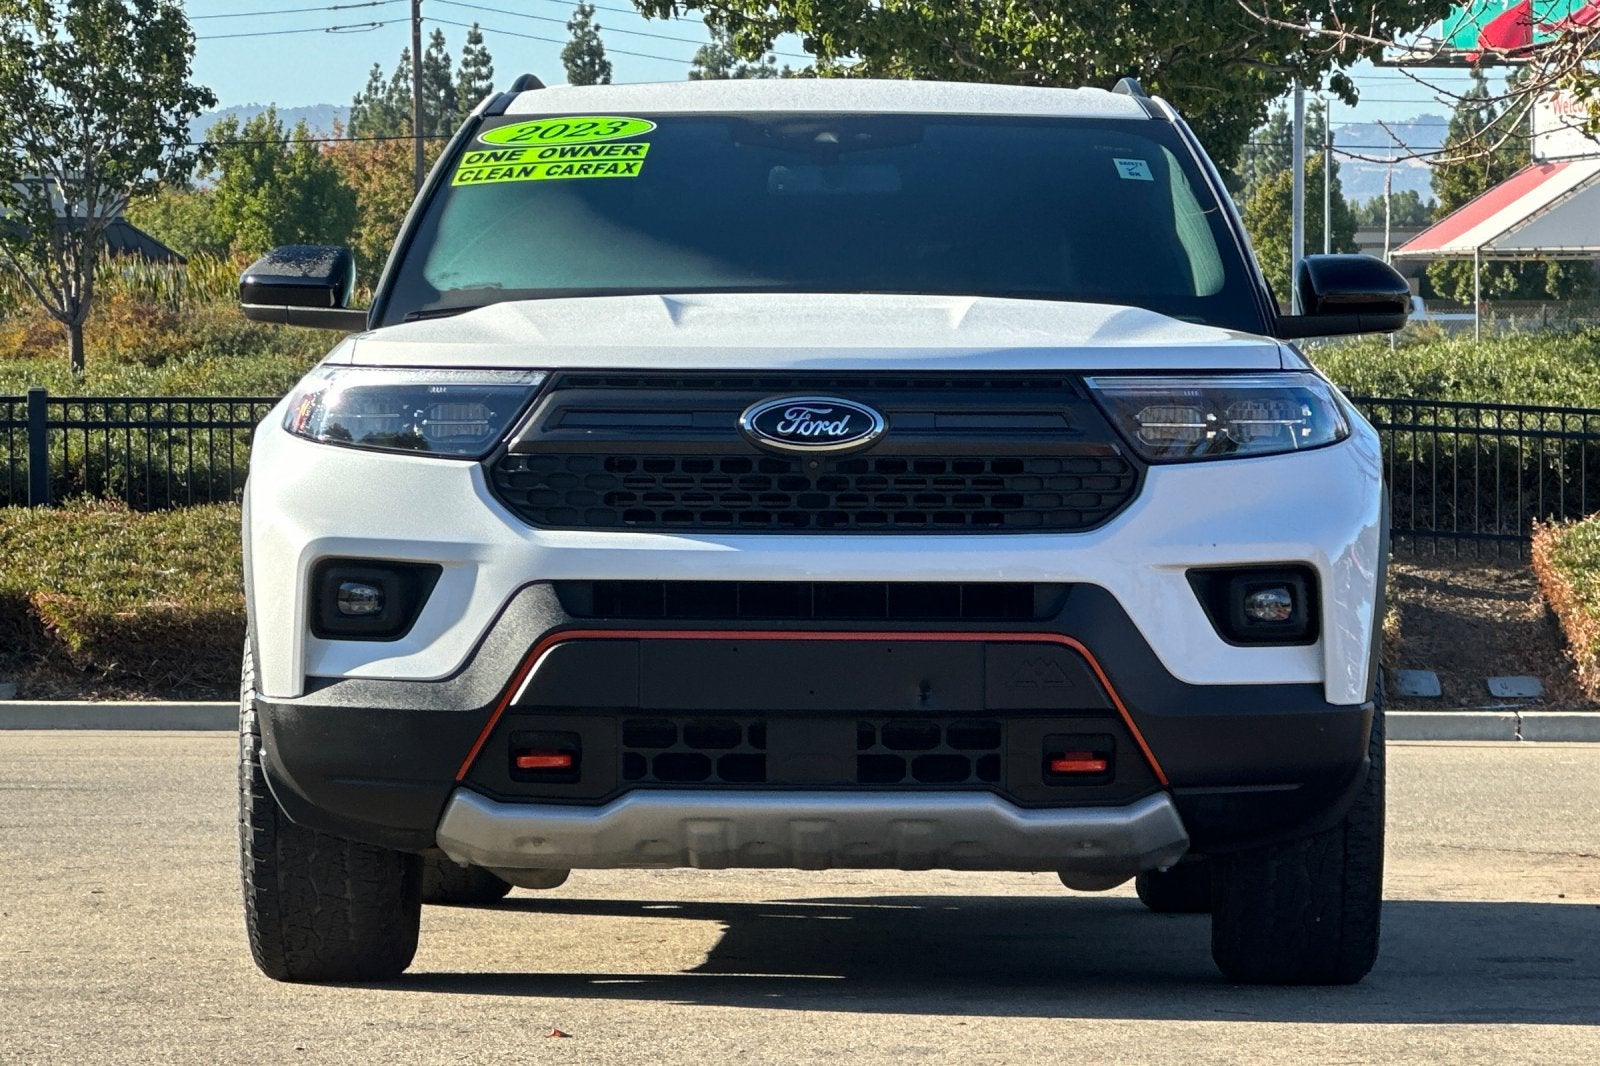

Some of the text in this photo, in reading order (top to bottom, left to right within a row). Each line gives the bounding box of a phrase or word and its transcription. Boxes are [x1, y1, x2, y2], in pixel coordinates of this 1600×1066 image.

[507, 121, 629, 143] 2023
[465, 144, 644, 165] ONE OWNER
[458, 162, 638, 183] CLEAN CARFAX
[776, 406, 850, 436] Ford
